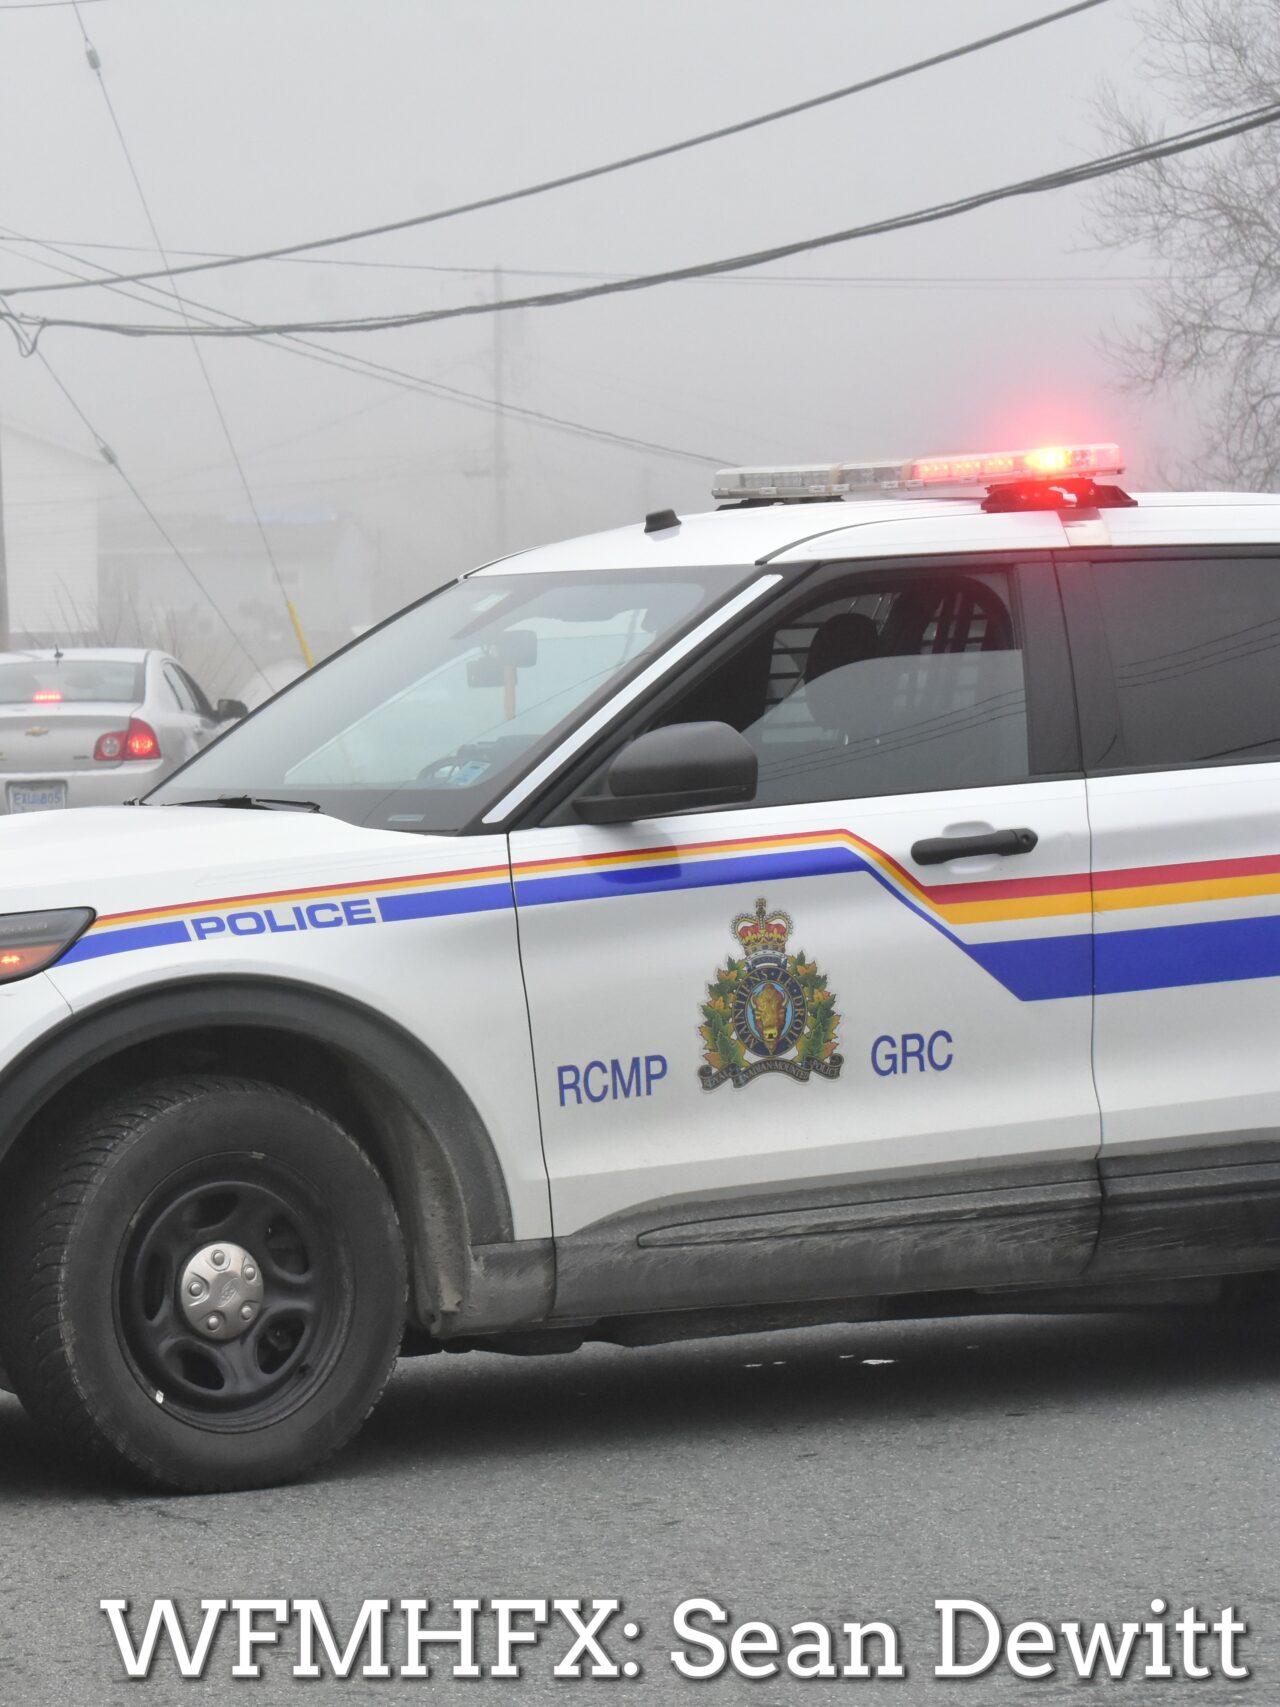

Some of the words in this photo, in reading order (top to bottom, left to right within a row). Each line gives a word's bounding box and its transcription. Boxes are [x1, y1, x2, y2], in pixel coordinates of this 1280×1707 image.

[190, 898, 377, 941] POLICE
[785, 995, 805, 1047] DROIT
[813, 1060, 840, 1077] POLICE
[871, 1029, 954, 1077] GRC
[558, 1055, 669, 1107] RCMP
